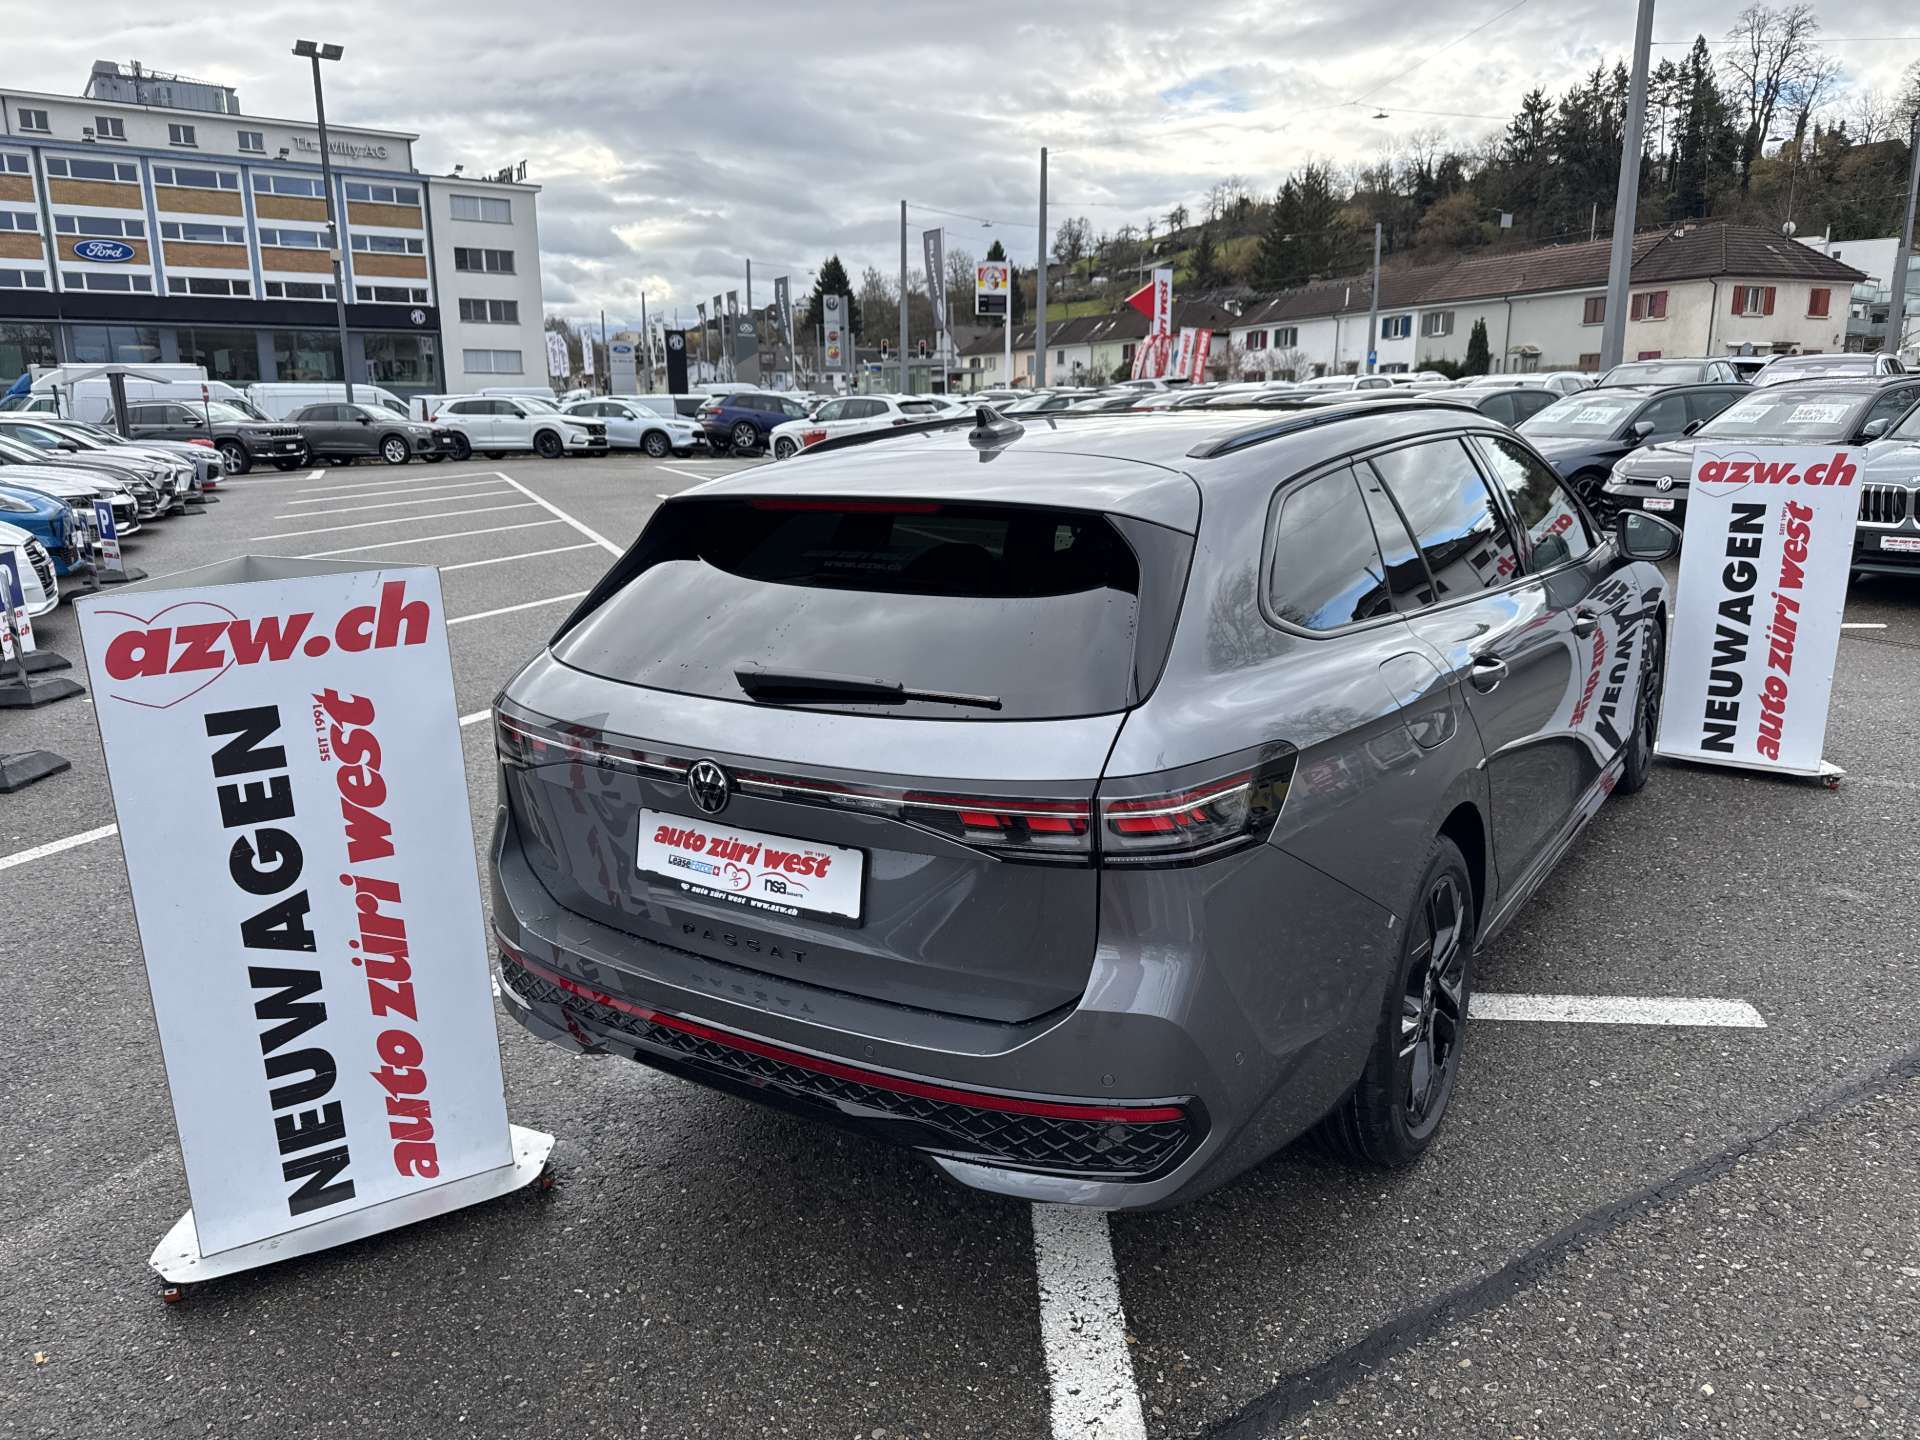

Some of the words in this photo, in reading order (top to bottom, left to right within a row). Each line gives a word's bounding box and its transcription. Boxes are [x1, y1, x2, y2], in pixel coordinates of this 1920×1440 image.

[365, 143, 388, 160] AG
[86, 242, 123, 258] Ford
[1698, 453, 1857, 487] azw.ch
[98, 508, 109, 534] P
[1779, 500, 1814, 589] west
[104, 580, 430, 680] azw.ch
[1700, 503, 1767, 753] NEUWAGEN
[1765, 592, 1800, 677] züri
[312, 704, 326, 733] 1991
[1756, 676, 1788, 760] auto
[312, 688, 396, 864] west
[318, 736, 330, 762] SEIT
[654, 825, 706, 852] auto
[706, 836, 763, 865] züri
[762, 848, 831, 879] west
[691, 886, 708, 895] auto
[727, 894, 747, 904] west
[764, 878, 787, 895] nsa
[204, 704, 356, 1217] NEUWAGEN
[339, 873, 418, 1022] züri
[683, 922, 807, 963] PASSAT
[369, 1029, 440, 1179] auto
